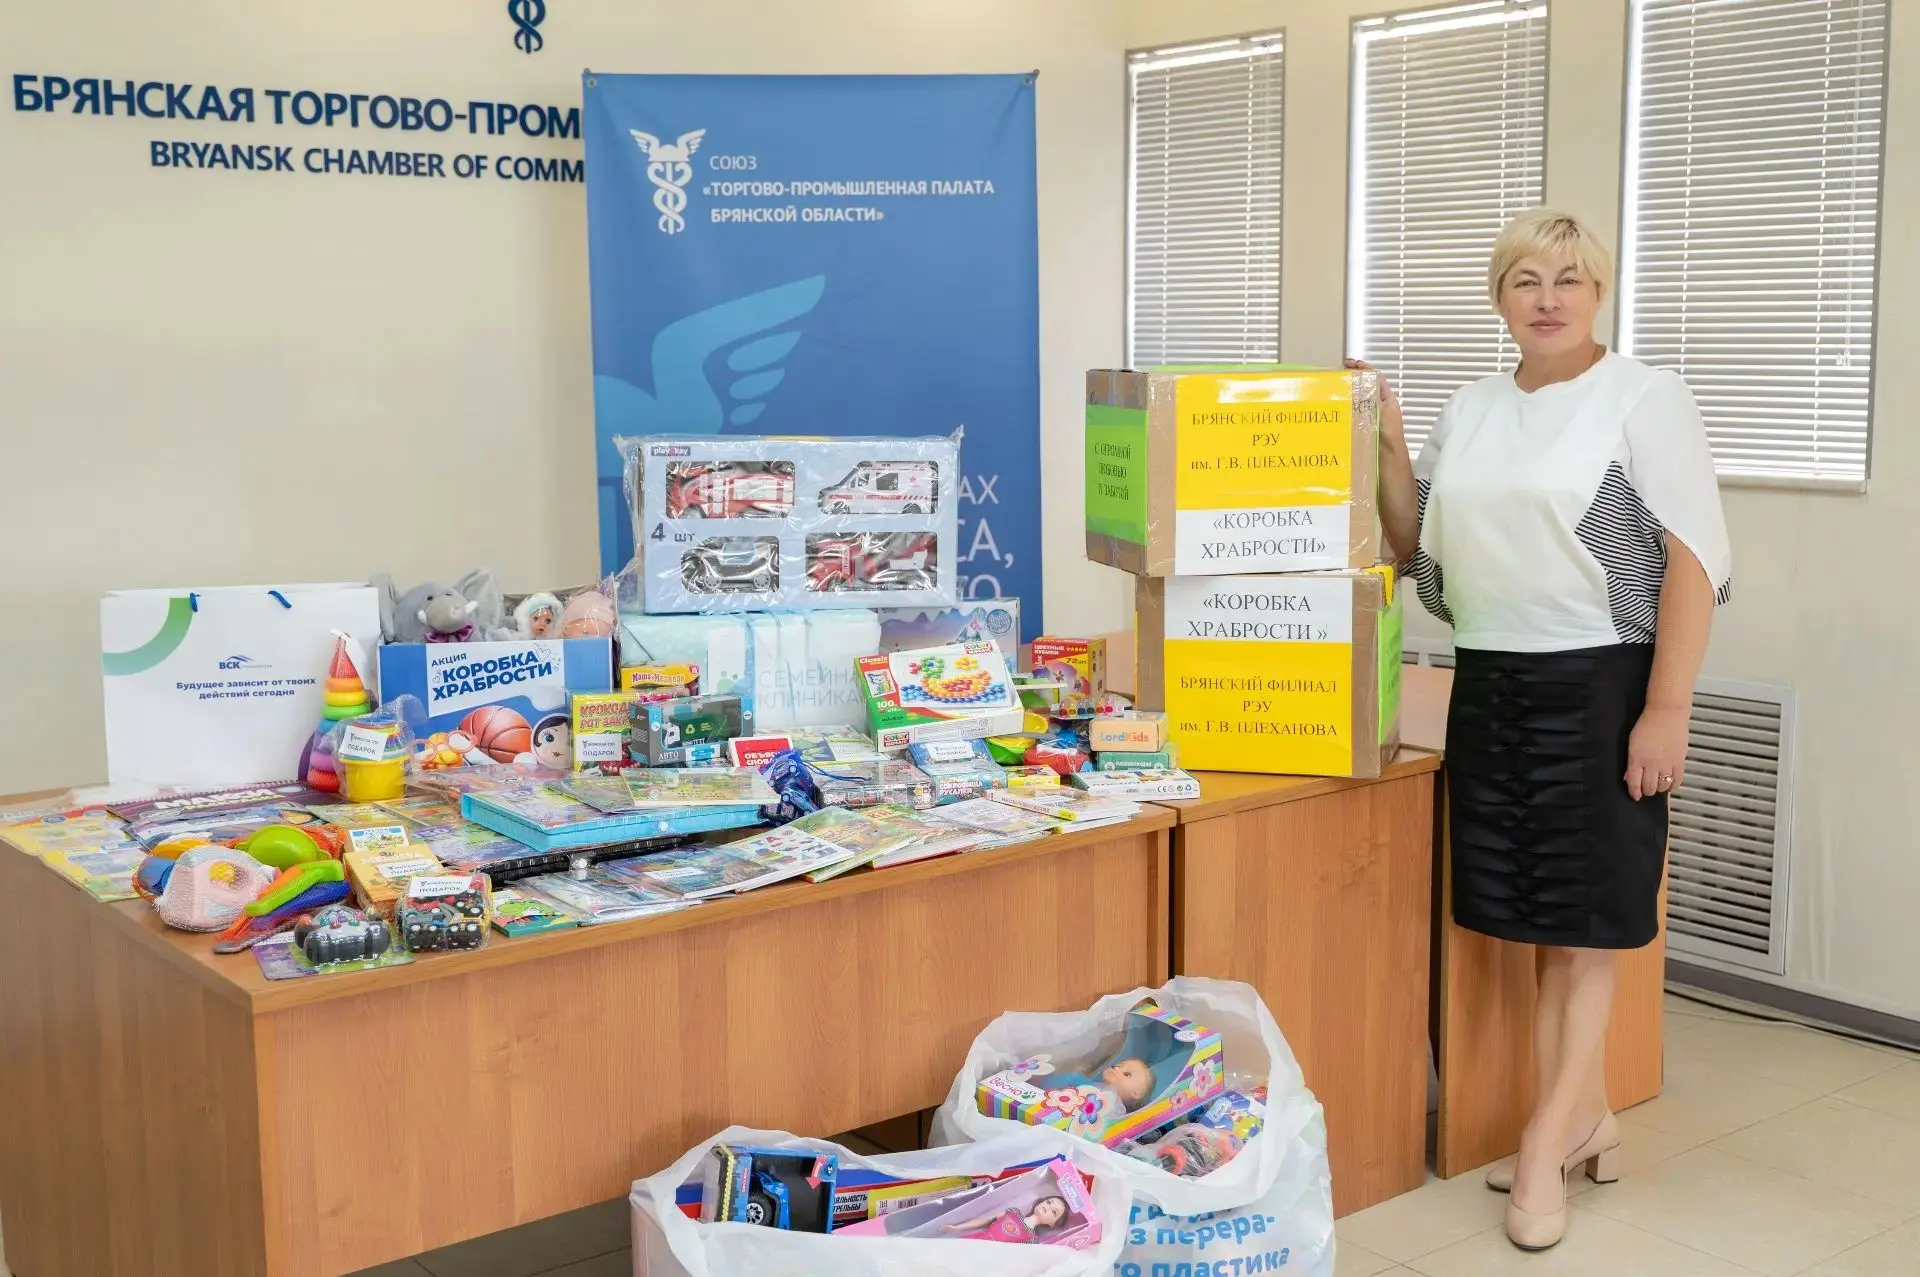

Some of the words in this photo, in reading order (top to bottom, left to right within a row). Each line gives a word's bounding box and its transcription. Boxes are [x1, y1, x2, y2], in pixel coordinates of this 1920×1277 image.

[13, 73, 255, 122] БРЯНСКАЯ
[150, 140, 294, 172] BRYANSK
[303, 147, 446, 178] CHAMBER
[453, 154, 488, 178] OF
[495, 156, 584, 183] COMM
[709, 155, 757, 171] СОЮЗ
[702, 181, 927, 197] «ТОРГОВО-ПРОМЫШЛЕННАЯ
[931, 180, 995, 195] ПАЛАТА
[710, 205, 797, 223] БРЯНСКОЙ
[802, 207, 885, 222] ОБЛАСТИ»
[1192, 410, 1273, 427] БРЯНСКИЙ
[1275, 410, 1340, 425] ФИЛИАЛ
[1252, 433, 1280, 447] РЭУ
[1191, 459, 1212, 471] им.
[1247, 455, 1339, 470] ПЛЕХАНОВА
[1213, 510, 1314, 530] «КОРОБКА
[650, 522, 666, 542] 4
[1201, 537, 1326, 560] ХРАБРОСТИ»
[1203, 593, 1312, 613] «КОРОБКА
[219, 661, 240, 670] ВСК
[431, 652, 467, 668] АКЦИЯ
[442, 650, 539, 683] КОРОБКА
[176, 681, 224, 692] Будущее
[226, 678, 270, 688] зависит
[271, 680, 284, 688] от
[285, 677, 316, 687] твоих
[432, 661, 553, 701] ХРАБРОСТИ
[1180, 675, 1263, 691] БРЯНСКИЙ
[1266, 677, 1337, 693] ФИЛИАЛ
[199, 688, 250, 700] действий
[252, 689, 295, 699] сегодня
[1242, 700, 1272, 713] РЭУ
[1180, 722, 1202, 733] им.
[1237, 721, 1338, 737] ПЛЕХАНОВА
[1156, 1214, 1275, 1250] перера-
[1151, 1247, 1290, 1277] пластика
